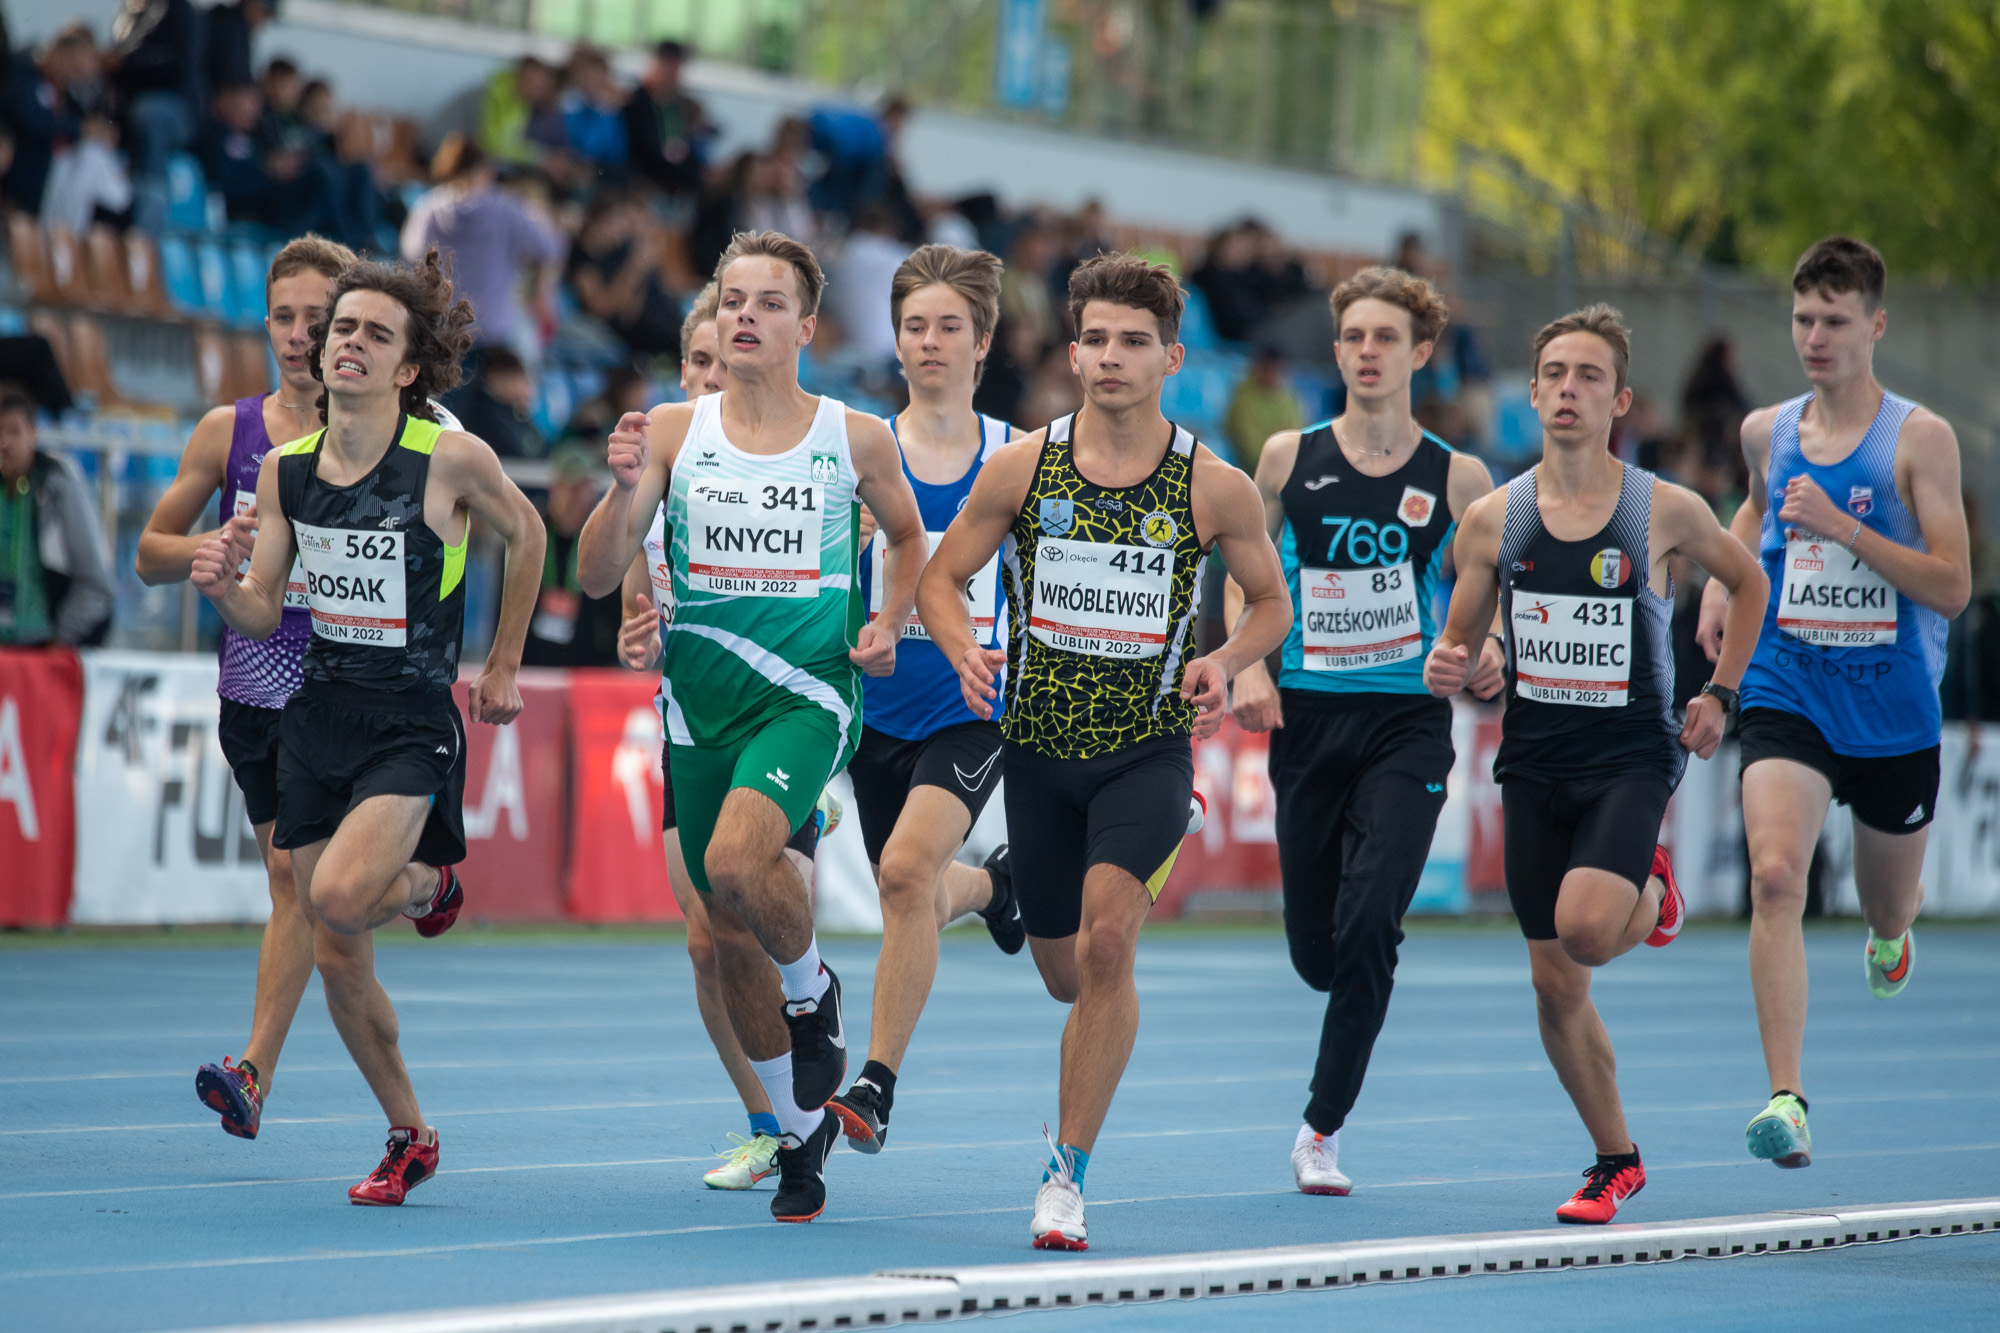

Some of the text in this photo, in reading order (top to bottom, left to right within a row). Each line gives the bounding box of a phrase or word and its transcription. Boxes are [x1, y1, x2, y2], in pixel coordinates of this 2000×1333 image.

[707, 490, 749, 504] FUEL
[762, 485, 816, 511] 341
[378, 517, 400, 529] 4F
[345, 535, 396, 560] 562
[705, 525, 803, 554] KNYCH
[1322, 516, 1408, 567] 769
[1070, 554, 1098, 563] Okęcie
[1109, 550, 1166, 576] 414
[307, 571, 386, 603] BOSAK
[709, 577, 797, 593] LUBLIN 2022
[1313, 588, 1343, 598] ORLEN
[1372, 569, 1401, 593] 83
[1039, 581, 1165, 618] WRÓBLEWSKI
[1788, 583, 1886, 609] LASECKI
[1307, 601, 1415, 634] GRZEŚKOWIAK
[1573, 602, 1624, 626] 431
[315, 622, 384, 641] LUBLIN 2022
[1796, 630, 1875, 642] LUBLIN 2022
[1052, 633, 1141, 655] LUBLIN 2022
[1519, 637, 1625, 667] JAKUBIEC
[1325, 648, 1404, 666] LUBLIN 2022
[1775, 649, 1890, 682] GROUP
[1531, 687, 1608, 703] LUBLIN 2022
